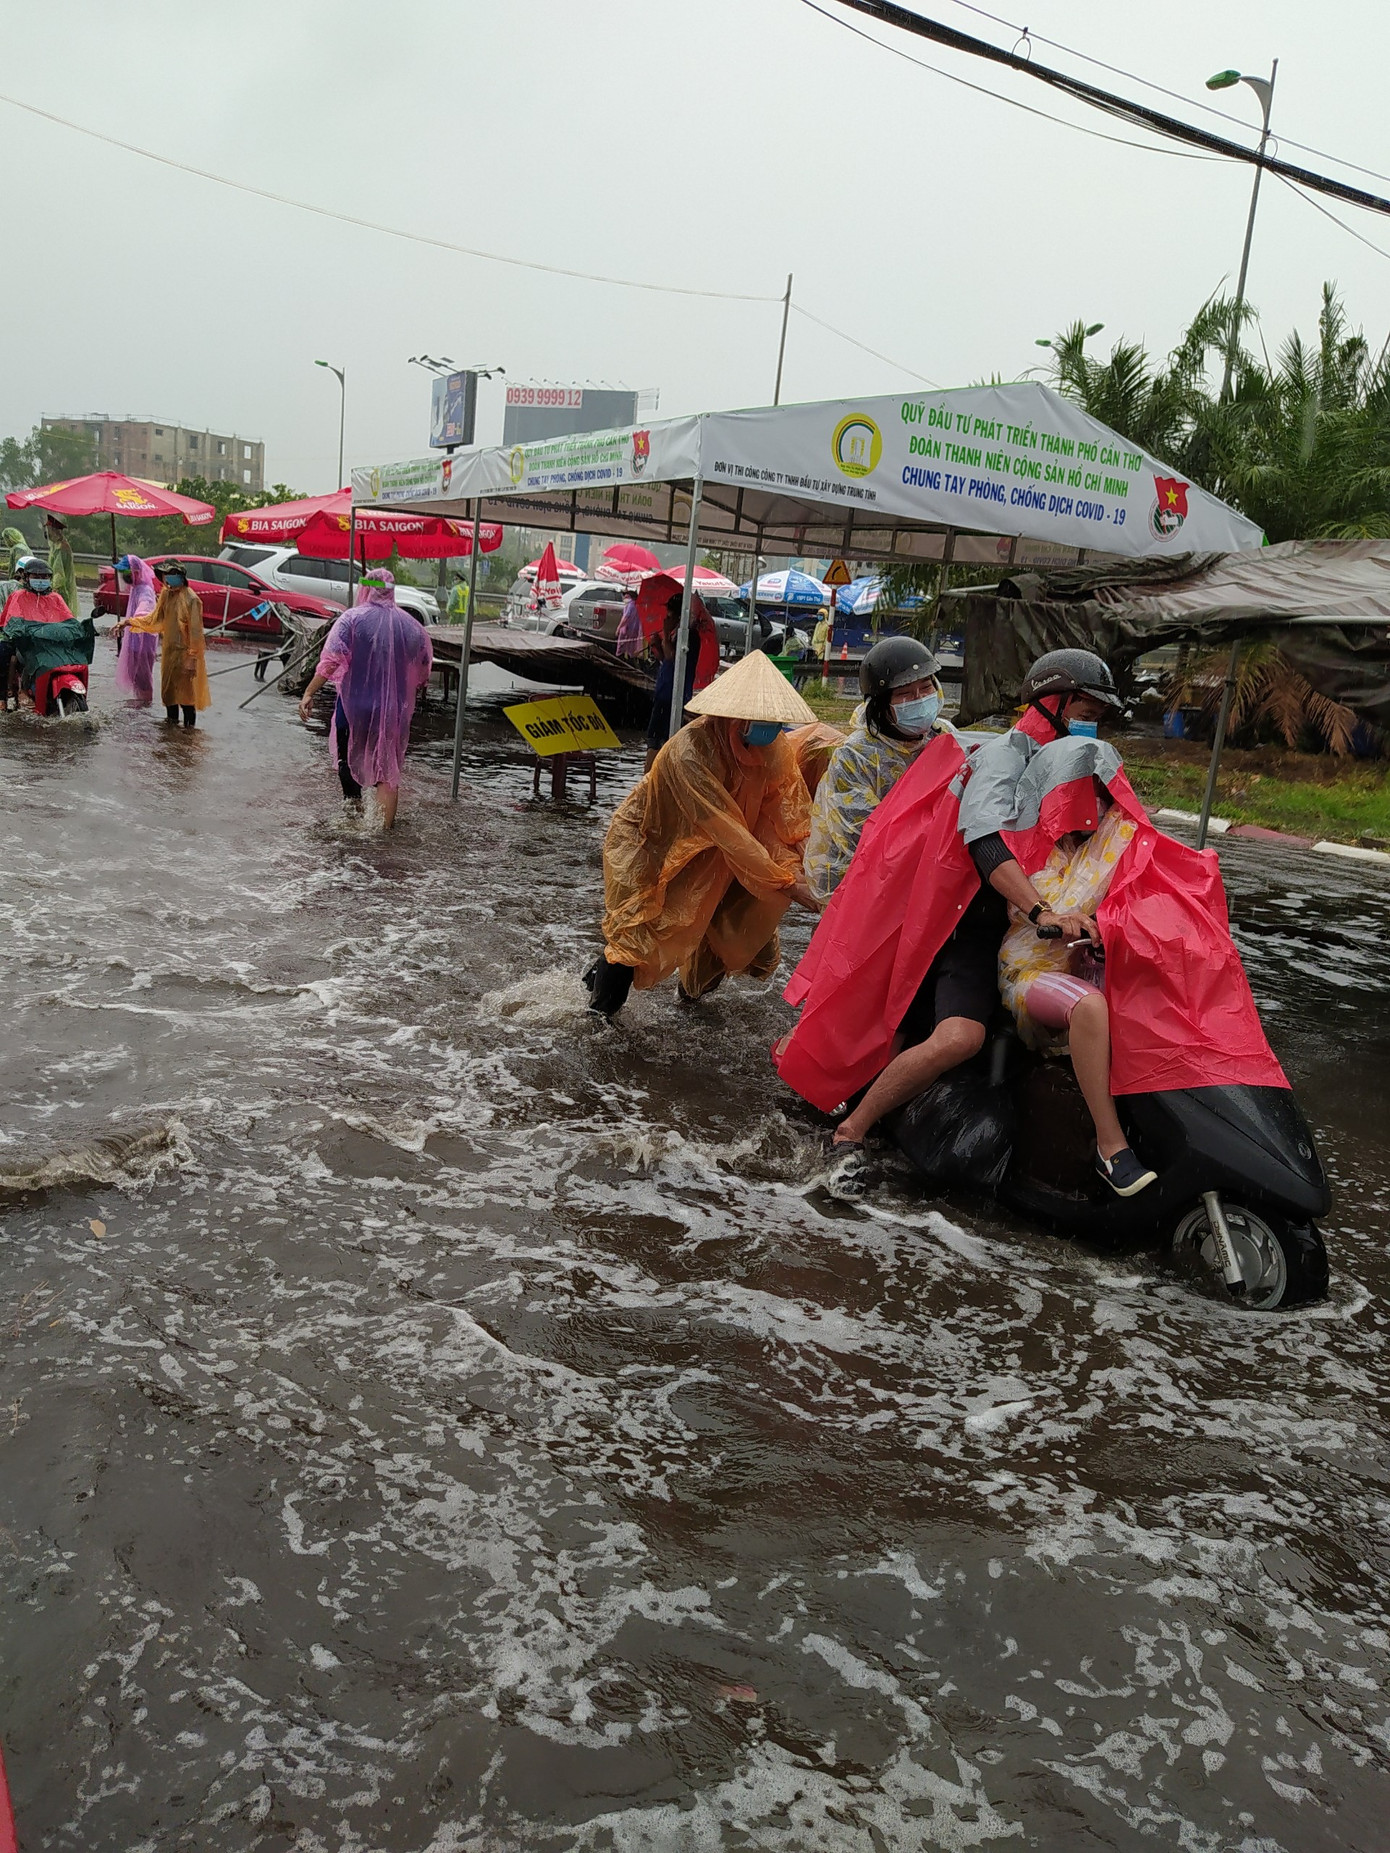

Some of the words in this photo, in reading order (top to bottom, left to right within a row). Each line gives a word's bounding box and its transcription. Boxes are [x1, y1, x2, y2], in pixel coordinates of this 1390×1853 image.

[506, 387, 535, 405] 0939
[537, 388, 565, 406] 9999
[567, 389, 581, 406] 12
[901, 400, 925, 425] QUỸ
[928, 402, 953, 431] ĐẦU
[956, 413, 973, 434] TƯ
[973, 417, 1003, 441] PHÁT
[1006, 420, 1038, 449] TRIỂN
[1040, 431, 1075, 457] THÀNH
[1077, 438, 1101, 462] PHỐ
[1100, 441, 1121, 467] CẦN
[1122, 452, 1144, 472] THƠ
[597, 468, 612, 480] COVID
[616, 467, 623, 478] 19
[909, 433, 942, 459] ĐOÀN
[945, 443, 982, 467] THANH
[984, 449, 1011, 473] NIÊN
[1013, 454, 1043, 480] CỘNG
[1043, 459, 1065, 485] SẢN
[1067, 463, 1084, 488] HỒ
[1084, 471, 1103, 493] CHÍ
[1103, 476, 1129, 498] MINH
[734, 464, 744, 476] THI
[744, 465, 760, 481] CÔNG
[760, 469, 776, 483] CÔNG
[776, 474, 783, 485] TY
[784, 475, 799, 487] TNHH
[846, 486, 864, 499] TRUNG
[902, 465, 942, 491] CHUNG
[944, 474, 967, 495] TAY
[968, 477, 1007, 506] PHÒNG,
[1011, 483, 1047, 511] CHỐNG
[1048, 494, 1074, 517] DỊCH
[1075, 499, 1105, 521] COVID
[1112, 508, 1127, 526] 19
[251, 520, 270, 531] BIA
[271, 517, 307, 530] SAIGON
[354, 519, 377, 531] BIA
[379, 521, 424, 532] SAIGON
[525, 716, 566, 739] GIẢM
[561, 710, 590, 733] TỐC
[587, 712, 607, 734] ĐỘ
